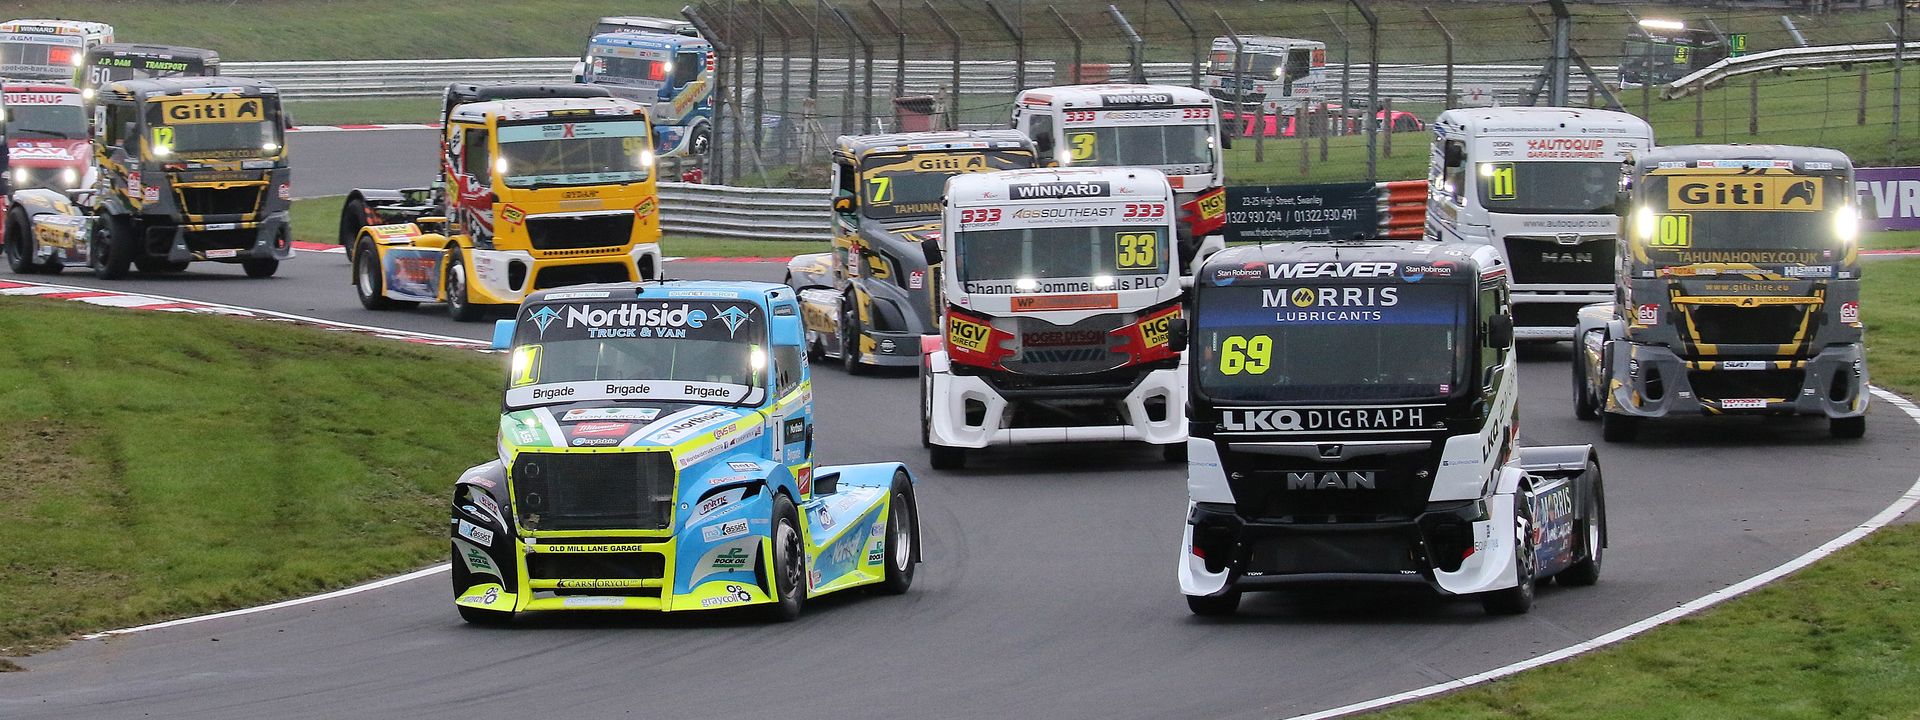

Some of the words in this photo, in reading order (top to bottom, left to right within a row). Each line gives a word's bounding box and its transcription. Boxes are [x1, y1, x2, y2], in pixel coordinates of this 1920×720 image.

[98, 58, 112, 66] J.P.
[114, 59, 131, 67] DAM
[145, 61, 187, 71] TRANSPORT
[91, 67, 110, 84] 50
[1107, 94, 1167, 104] WINNARD
[170, 104, 226, 120] Giti
[1066, 111, 1096, 121] 333
[1183, 109, 1211, 119] 333
[153, 127, 174, 150] 12
[1538, 139, 1604, 150] AUTOQUIP
[1071, 133, 1095, 160] 3
[1526, 150, 1558, 158] GARAGE
[1560, 150, 1604, 159] EQUIPMENT
[918, 159, 958, 169] Giti
[1493, 167, 1513, 195] 11
[870, 177, 889, 202] 7
[1017, 184, 1101, 198] WINNARD
[1678, 182, 1763, 205] Giti
[1241, 196, 1259, 206] 23-25
[1260, 195, 1275, 207] High
[1297, 195, 1322, 206] Swanley
[960, 207, 1002, 223] 333
[1123, 203, 1165, 218] 333
[1248, 211, 1264, 222] 930
[1266, 210, 1281, 222] 294
[1294, 209, 1321, 222] 01322
[1323, 208, 1339, 220] 930
[1341, 208, 1357, 220] 491
[1651, 215, 1687, 246] 101
[1118, 233, 1155, 267] 33
[1541, 252, 1593, 262] MAN
[1677, 251, 1818, 264] TAHUNAHONEY.CO.UK
[1231, 268, 1261, 276] Robinson
[1268, 262, 1397, 279] WEAVER
[1405, 265, 1420, 273] Stan
[1420, 265, 1451, 273] Robinson
[1135, 276, 1165, 290] PLC
[1705, 283, 1789, 292] www.giti-tire.eu
[1262, 287, 1398, 308] MORRIS
[567, 302, 708, 329] Northside
[1276, 310, 1381, 322] LUBRICANTS
[587, 327, 636, 338] TRUCK
[640, 326, 652, 337] &
[656, 327, 686, 338] VAN
[951, 319, 987, 341] HGV
[1023, 332, 1063, 346] ROGER
[1066, 329, 1105, 343] DYSON
[952, 335, 979, 348] DIRECT
[1220, 335, 1272, 376] 69
[515, 347, 538, 385] 1
[533, 386, 575, 399] Brigade
[606, 384, 650, 396] Brigade
[684, 384, 730, 397] Brigade
[1222, 409, 1305, 431] LKQ
[1308, 407, 1423, 429] DIGRAPH
[1287, 471, 1376, 490] MAN
[610, 544, 642, 552] GARAGE
